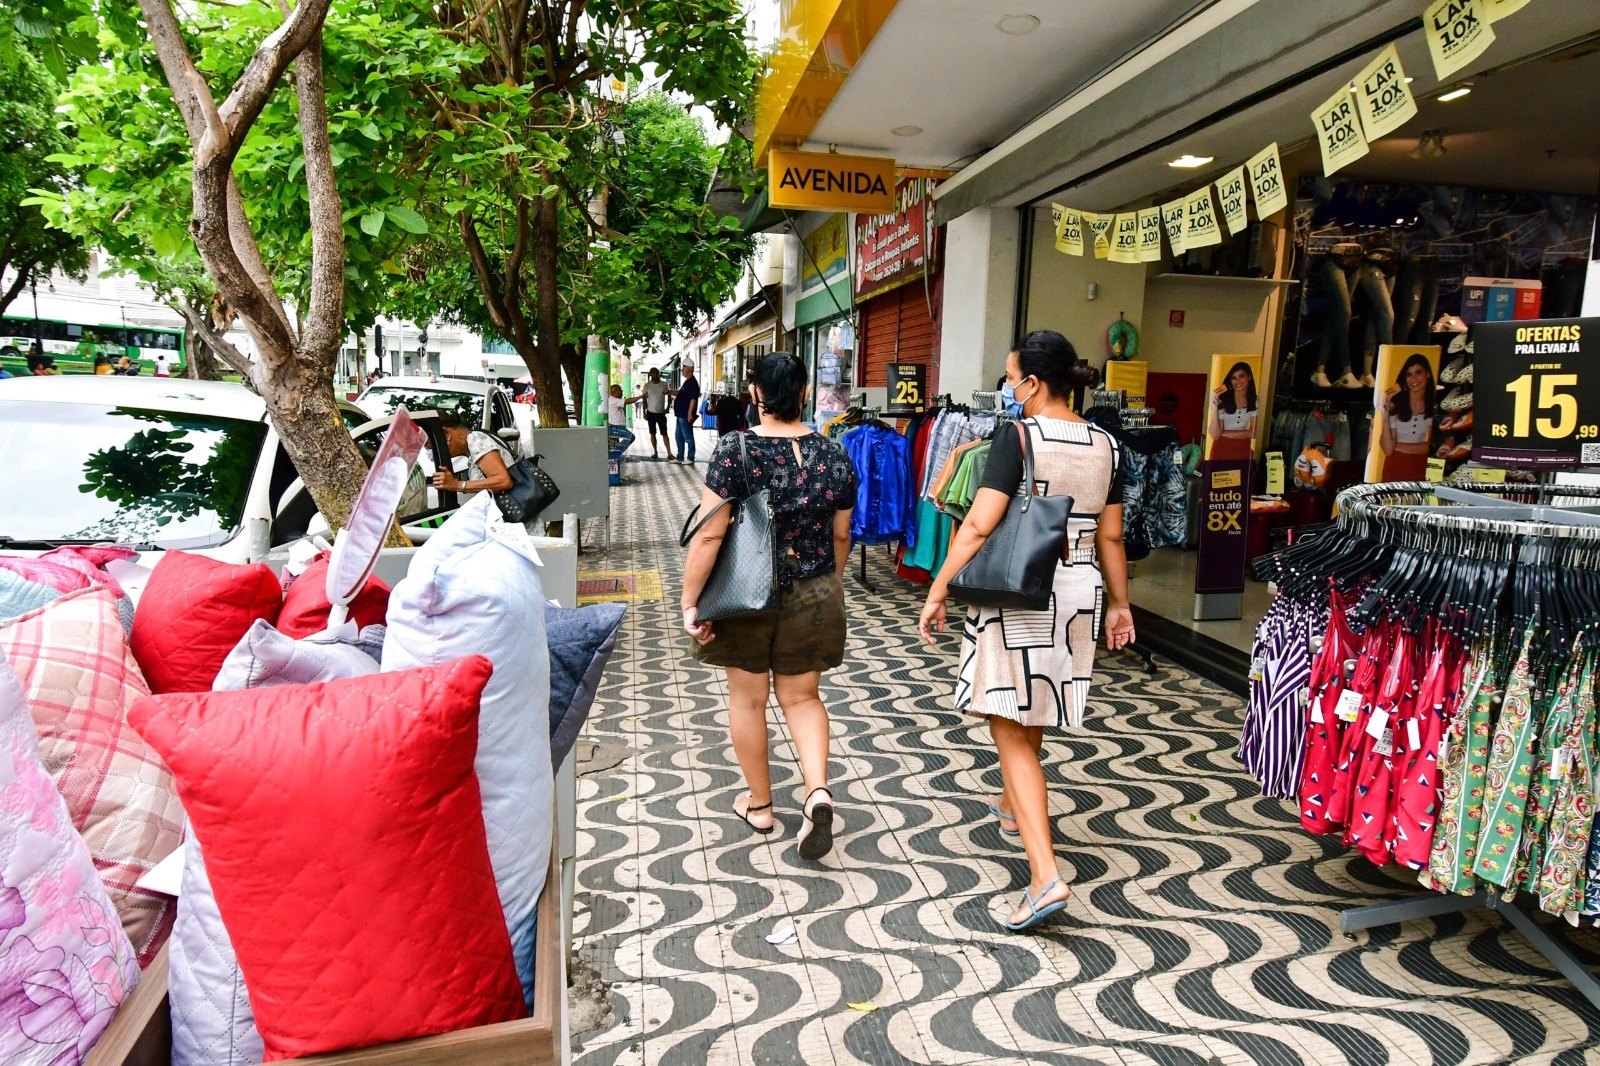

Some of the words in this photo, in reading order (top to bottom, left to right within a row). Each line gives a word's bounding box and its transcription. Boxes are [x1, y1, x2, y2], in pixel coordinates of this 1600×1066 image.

[1440, 7, 1477, 48] 10X
[1443, 42, 1459, 54] SEM
[1461, 21, 1480, 42] JUROS
[1365, 62, 1396, 96] LAR
[1370, 79, 1402, 113] 10X
[1372, 108, 1386, 118] SEM
[1389, 93, 1405, 109] JUROS
[1321, 102, 1350, 132] LAR
[1327, 119, 1355, 149] 10X
[1329, 144, 1339, 154] SEM
[1341, 133, 1357, 146] JUROS
[1253, 157, 1276, 181] LAR
[779, 167, 888, 196] AVENIDA
[1221, 180, 1241, 200] LAR
[1256, 173, 1278, 197] 10X
[1189, 198, 1210, 215] LAR
[1223, 195, 1241, 215] 10X
[1141, 217, 1158, 229] LAR
[1165, 208, 1183, 224] LAR
[1188, 213, 1214, 229] 10X
[1062, 228, 1080, 239] 10X
[1119, 221, 1135, 232] LAR
[1117, 235, 1136, 245] 10X
[1142, 231, 1158, 243] 10X
[1516, 325, 1581, 342] OFERTAS
[1515, 344, 1535, 355] PRA
[1536, 343, 1567, 354] LEVAR
[1568, 340, 1580, 353] JÁ
[896, 381, 918, 404] 25
[1492, 424, 1508, 437] R$
[1506, 374, 1578, 439] 15
[1209, 490, 1242, 502] tudo
[1226, 501, 1242, 510] até
[1207, 510, 1242, 531] 8X
